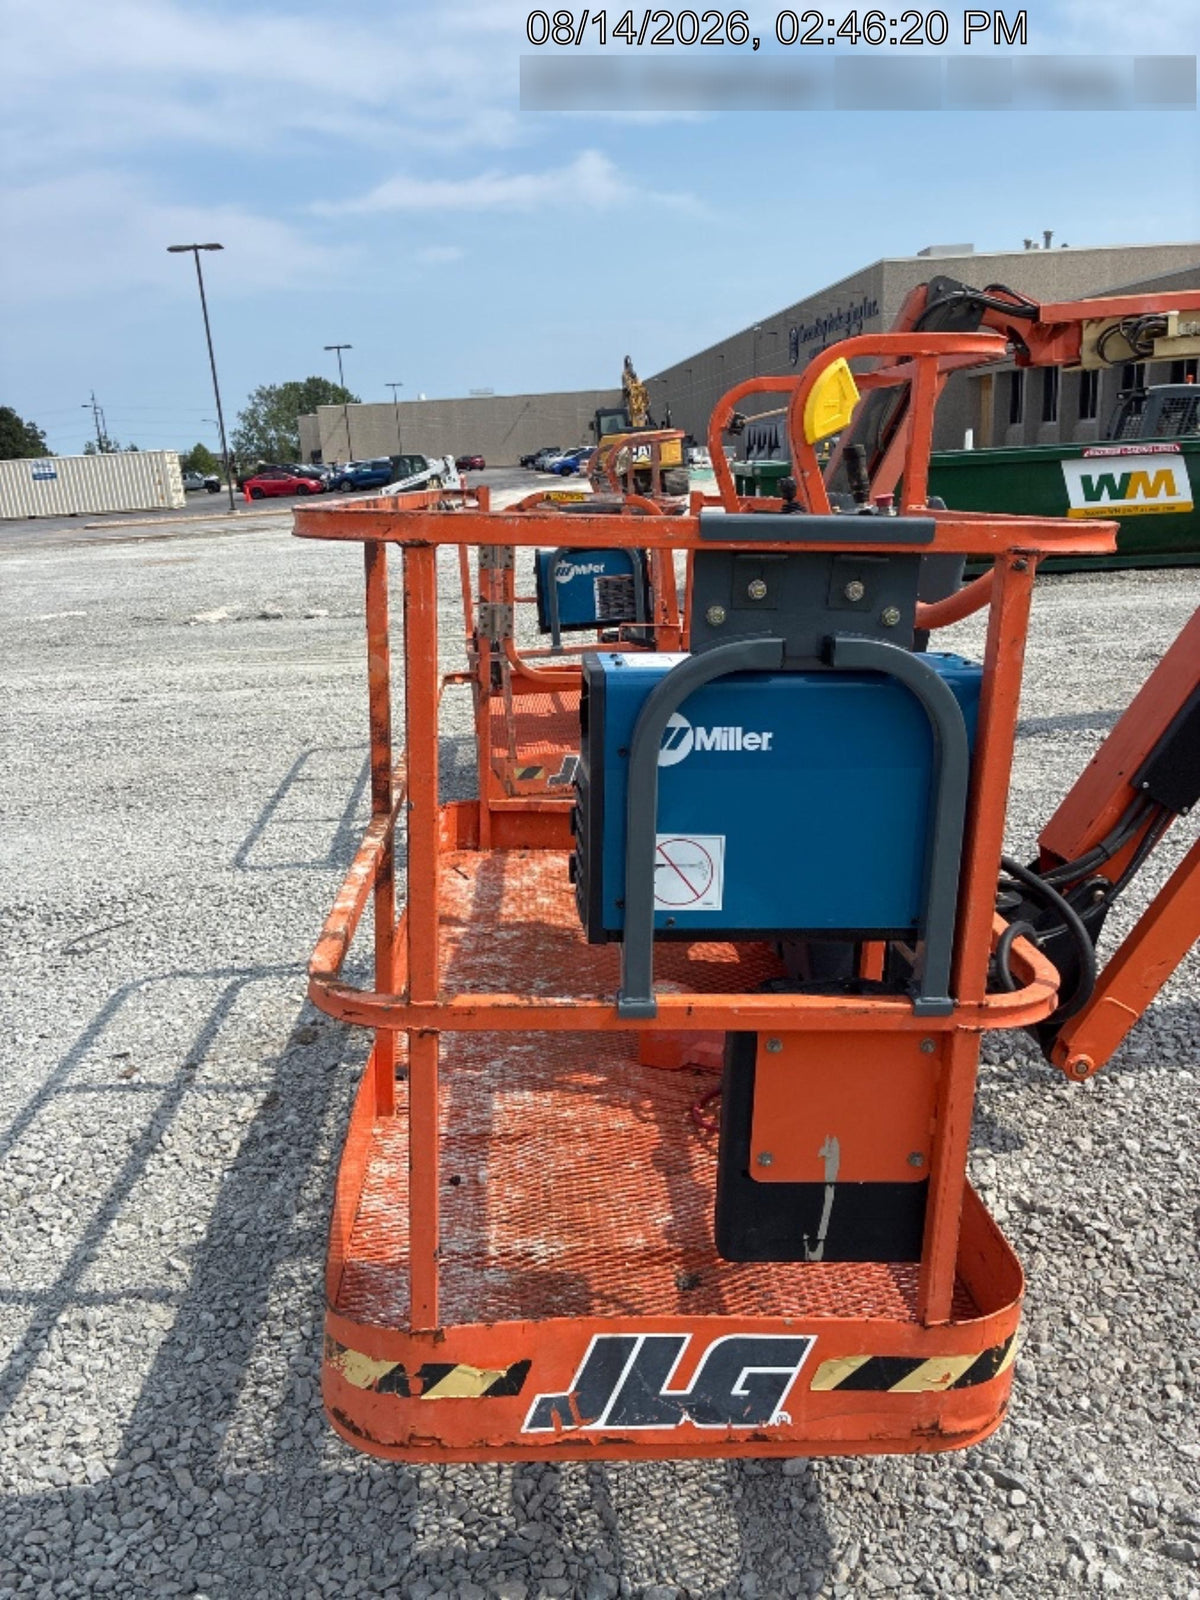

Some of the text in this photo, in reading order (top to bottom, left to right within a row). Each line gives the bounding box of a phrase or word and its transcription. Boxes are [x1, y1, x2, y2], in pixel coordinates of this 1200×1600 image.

[1081, 469, 1177, 502] WM
[571, 563, 605, 576] Miller
[694, 726, 773, 751] Miller
[521, 1333, 818, 1433] JLG
